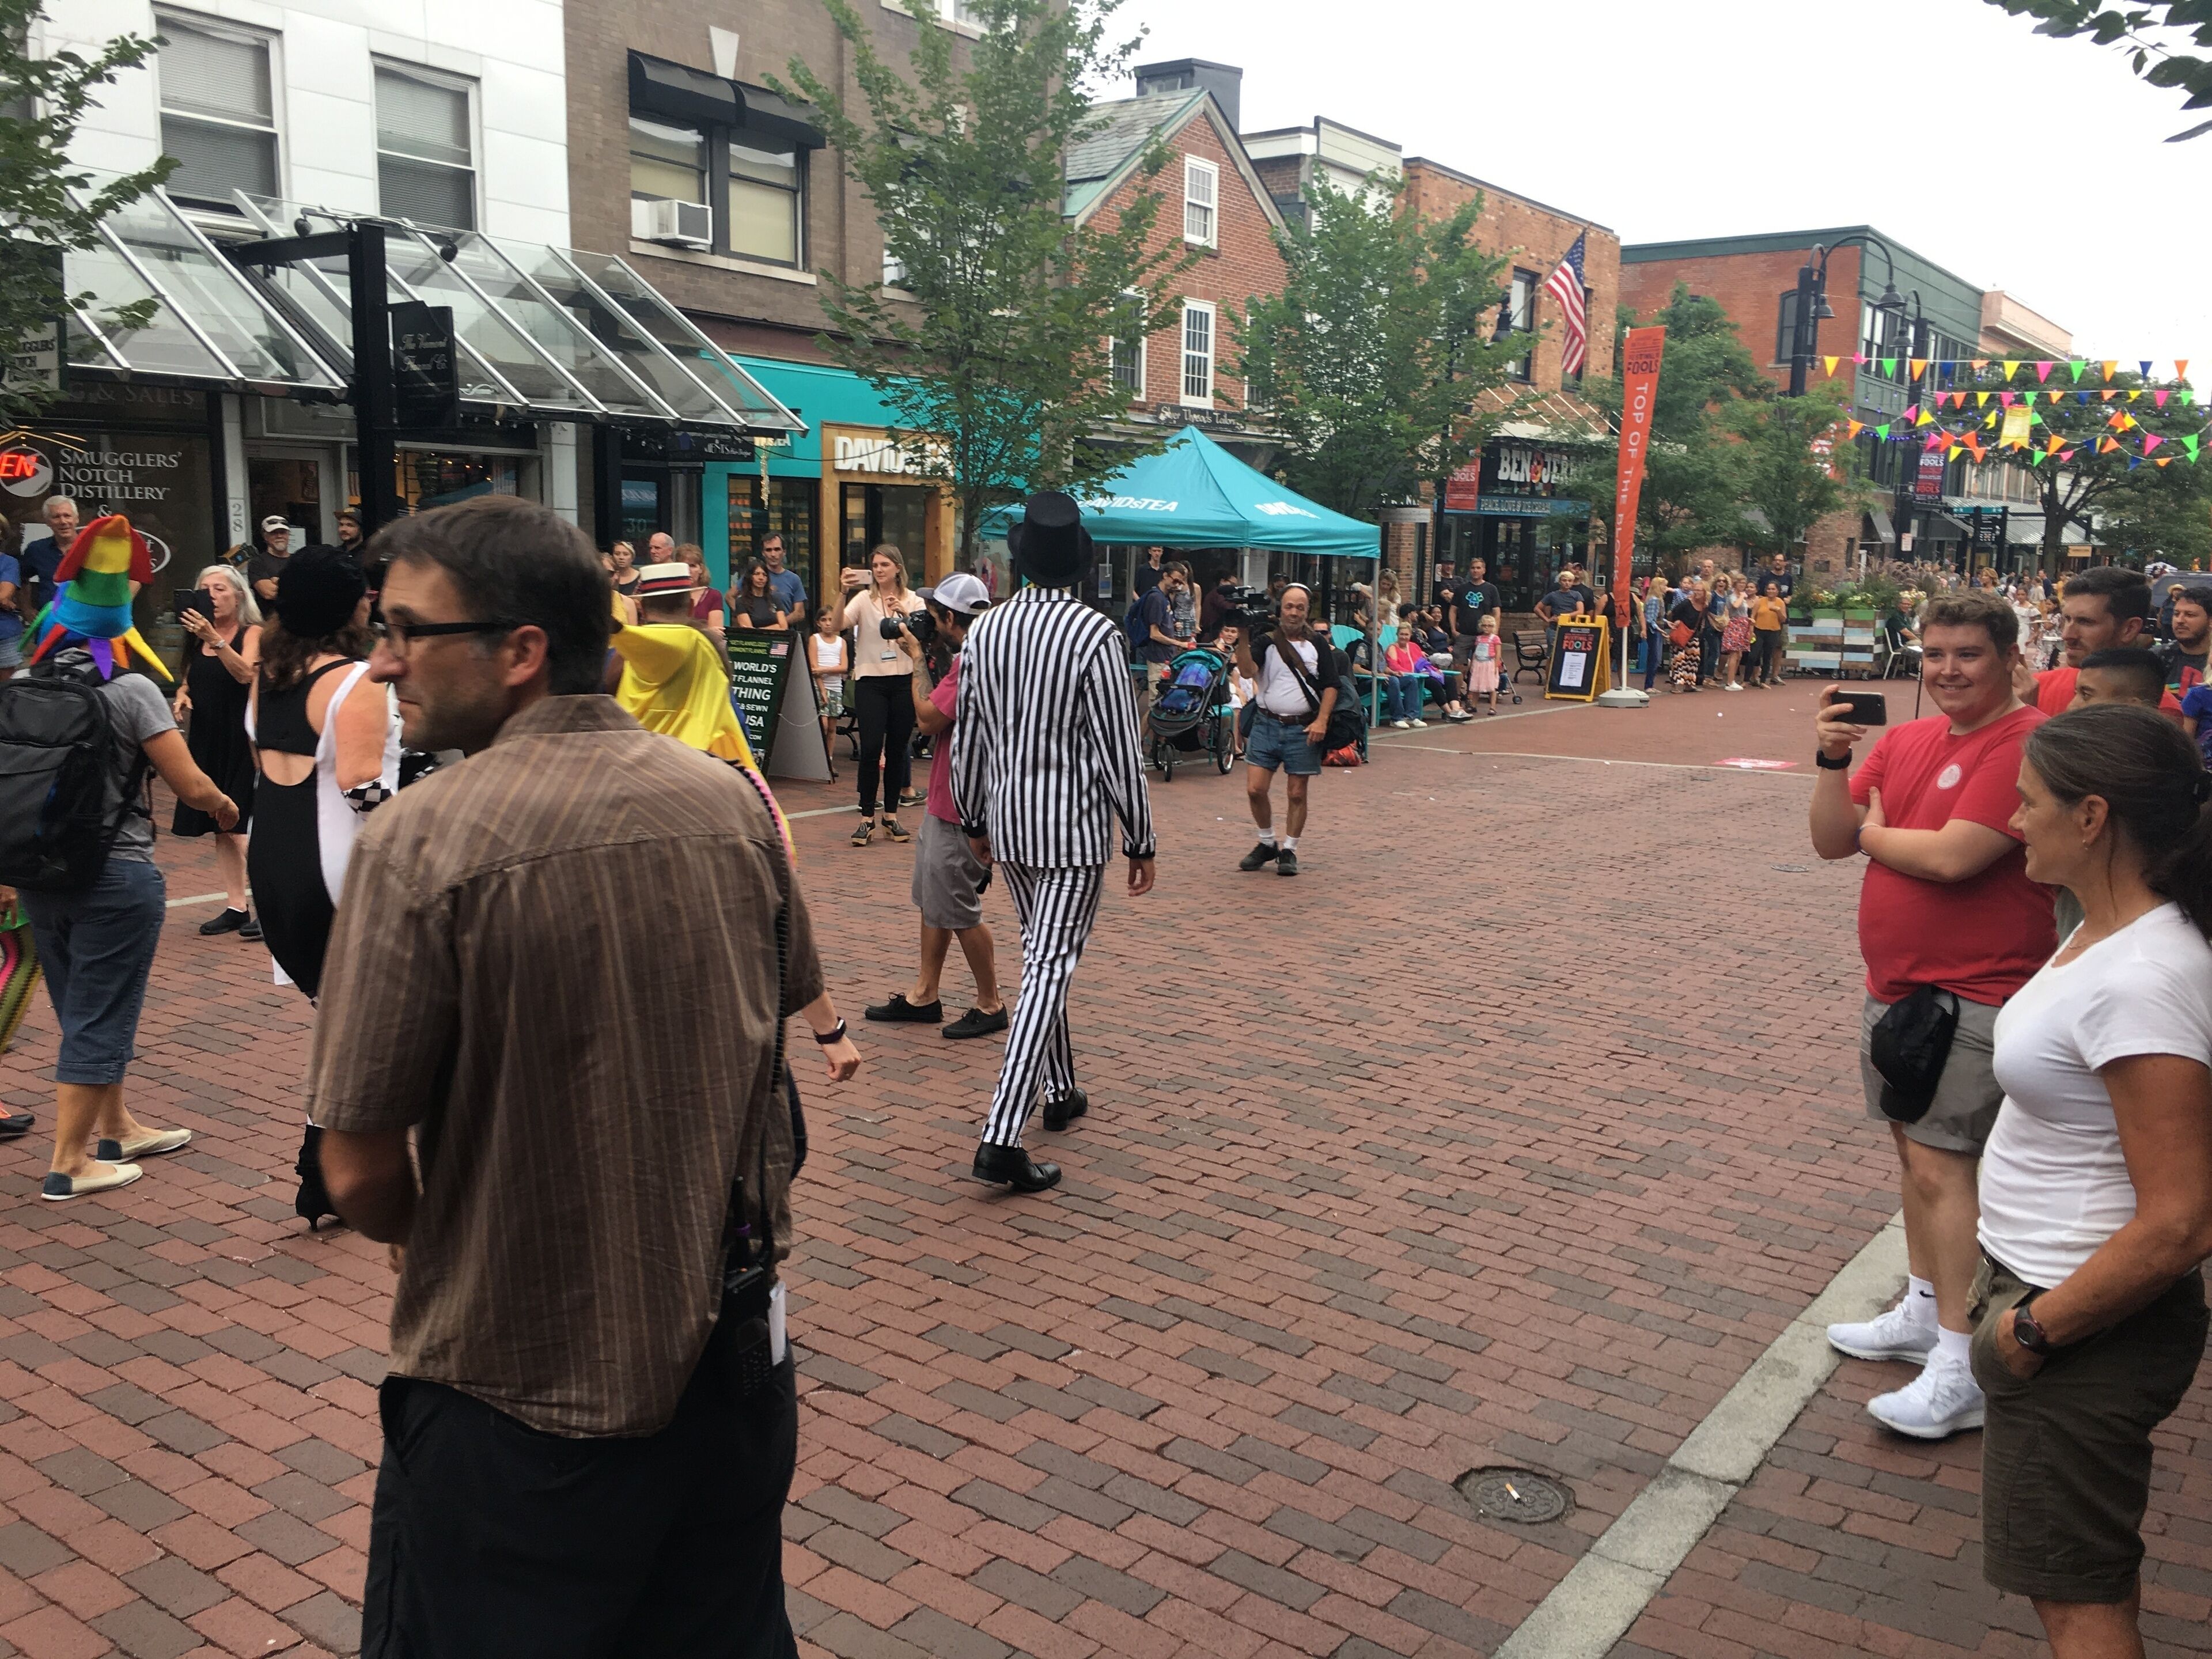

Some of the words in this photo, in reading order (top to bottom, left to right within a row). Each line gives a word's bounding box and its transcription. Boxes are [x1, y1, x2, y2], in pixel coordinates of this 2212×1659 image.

[1633, 382, 1649, 423] TOP
[1627, 430, 1641, 459] OF
[59, 448, 183, 468] SMUGGLERS'
[1497, 448, 1532, 482] BEN
[1919, 459, 1944, 467] FOOLS
[59, 465, 134, 483] NOTCH
[60, 482, 166, 501] DISTILLERY
[1619, 465, 1634, 505] THE
[97, 504, 112, 517] &
[1562, 640, 1593, 652] FOOLS
[733, 661, 778, 673] WORLD'S
[737, 675, 774, 685] FLANNEL
[745, 703, 769, 712] SEWN
